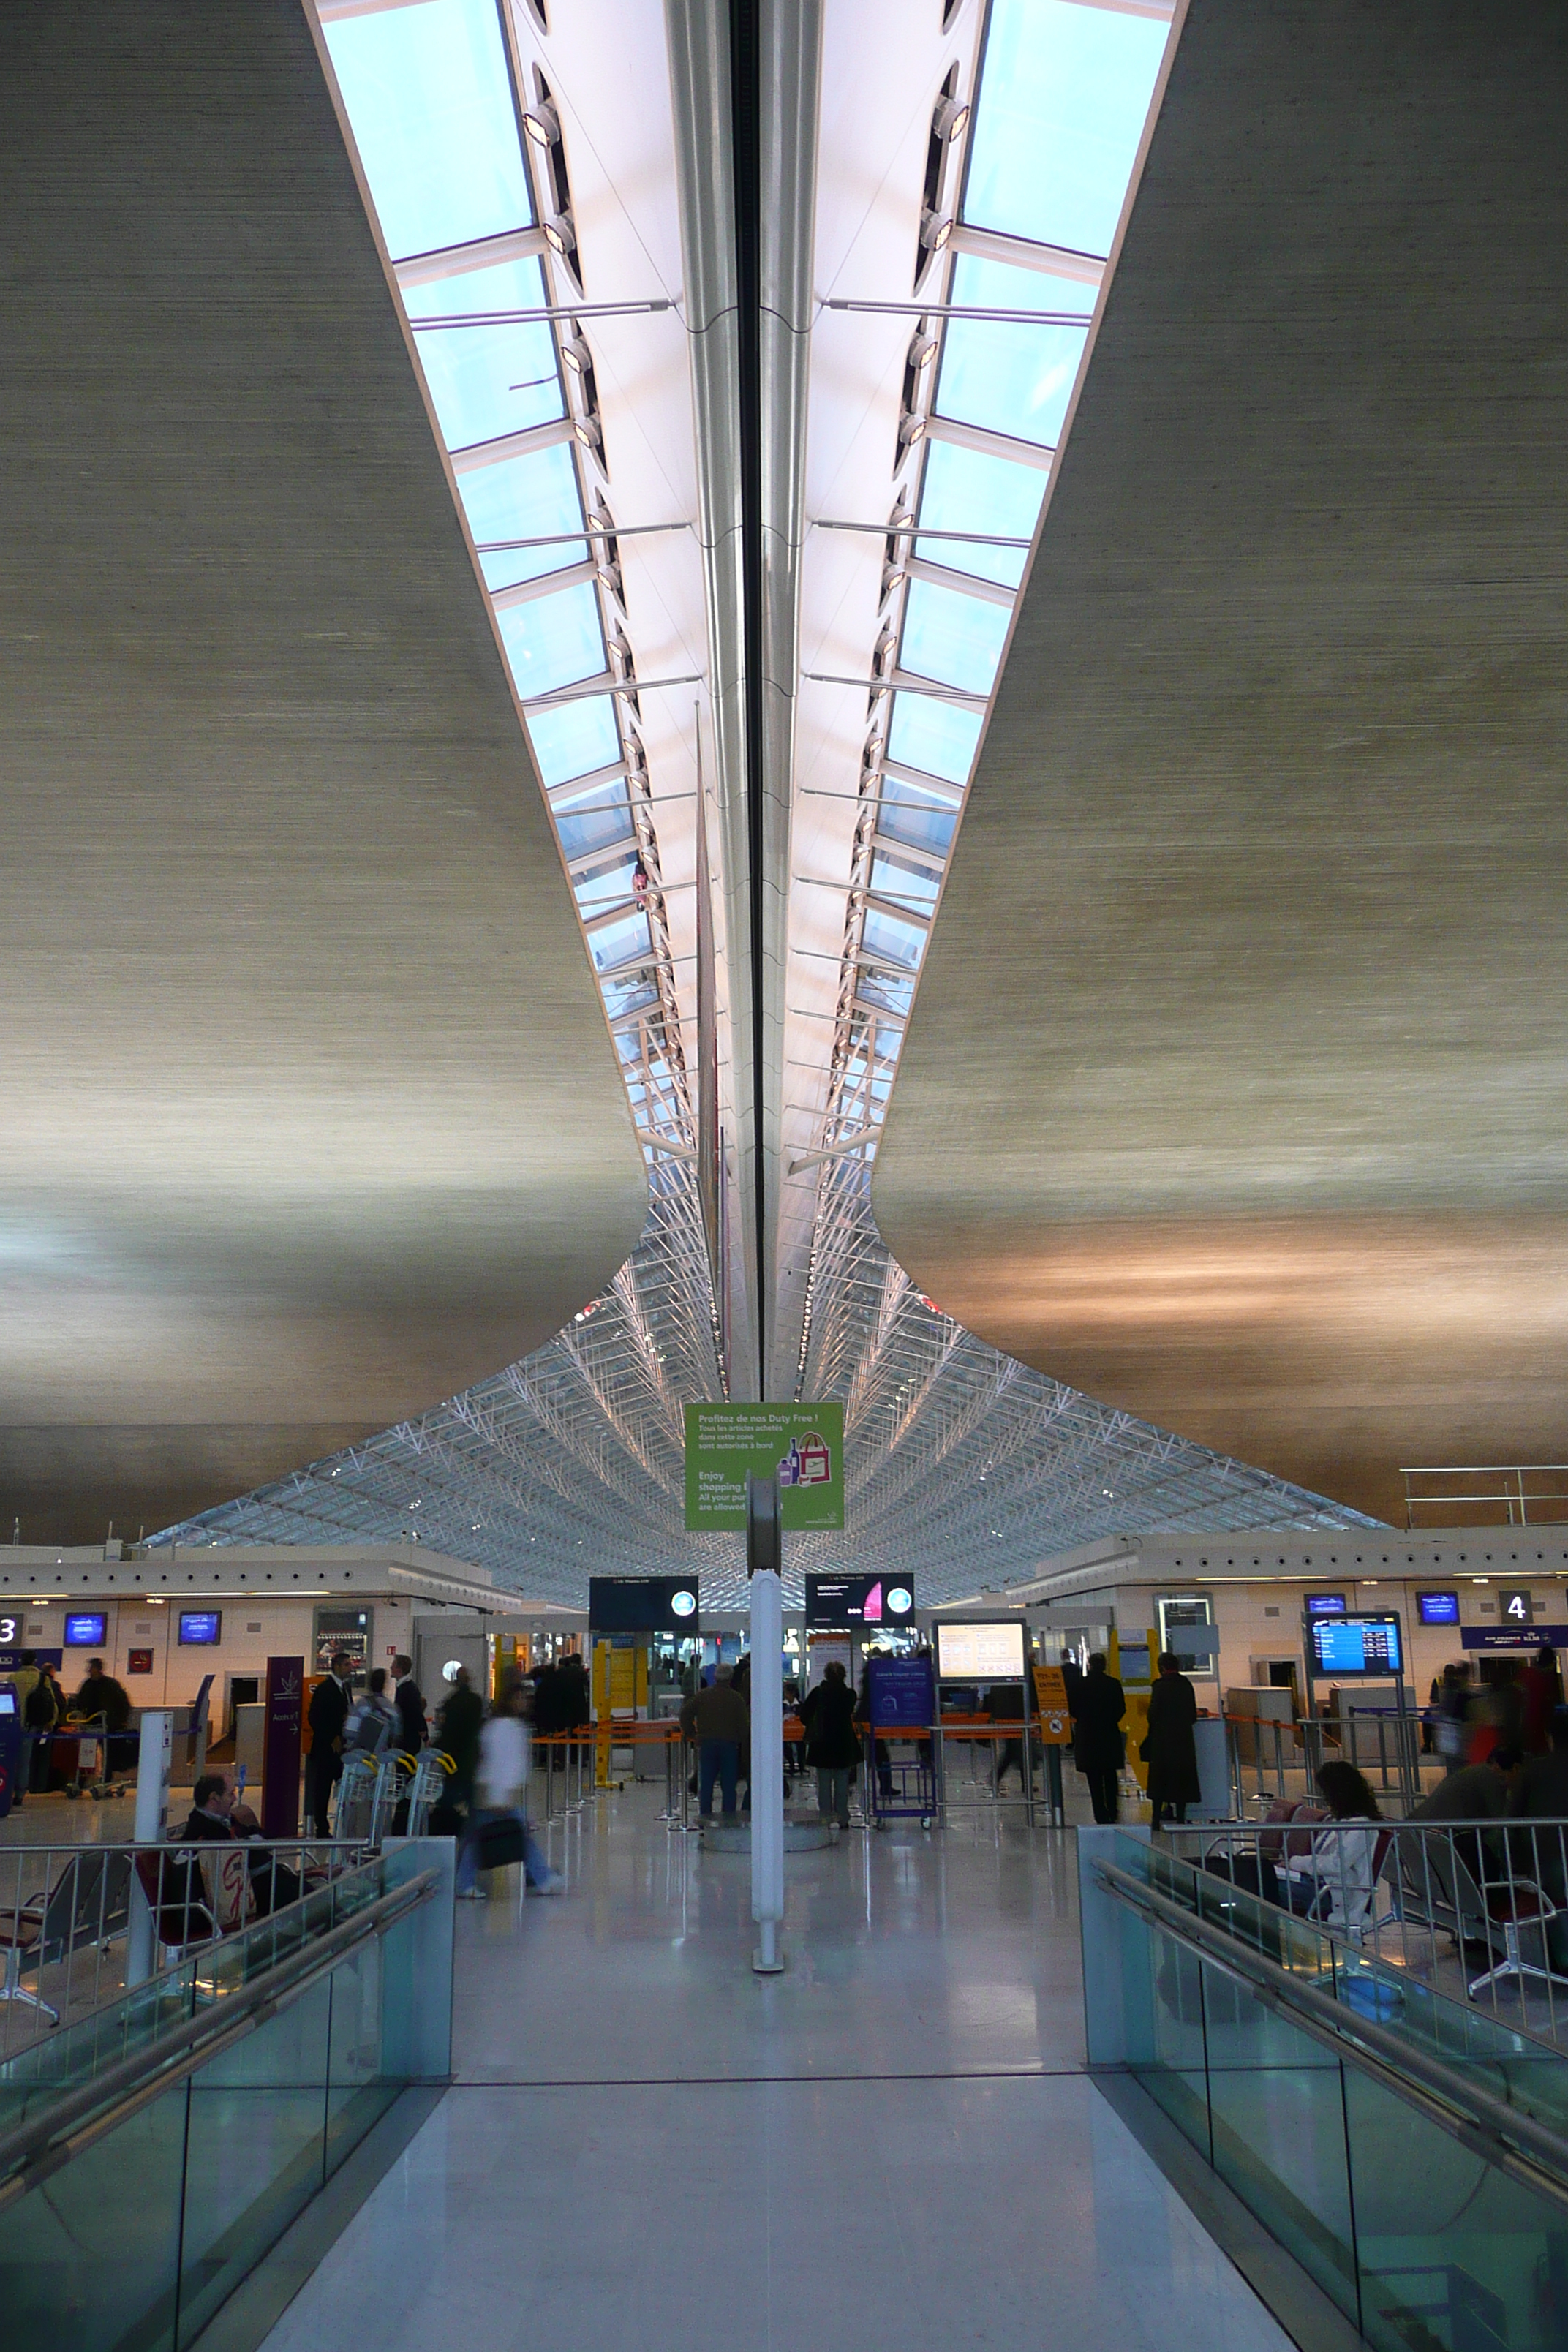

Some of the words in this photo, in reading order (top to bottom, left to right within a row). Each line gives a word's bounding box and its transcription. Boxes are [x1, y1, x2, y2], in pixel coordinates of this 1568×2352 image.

[698, 1414, 734, 1423] Profitez
[736, 1414, 748, 1423] de
[769, 1414, 790, 1425] Duty
[793, 1414, 813, 1422] Free
[698, 1471, 724, 1482] Enjoy
[698, 1482, 742, 1493] shopping
[714, 1503, 745, 1511] allowed
[1508, 1596, 1526, 1618] 4
[0, 1618, 15, 1642] 3
